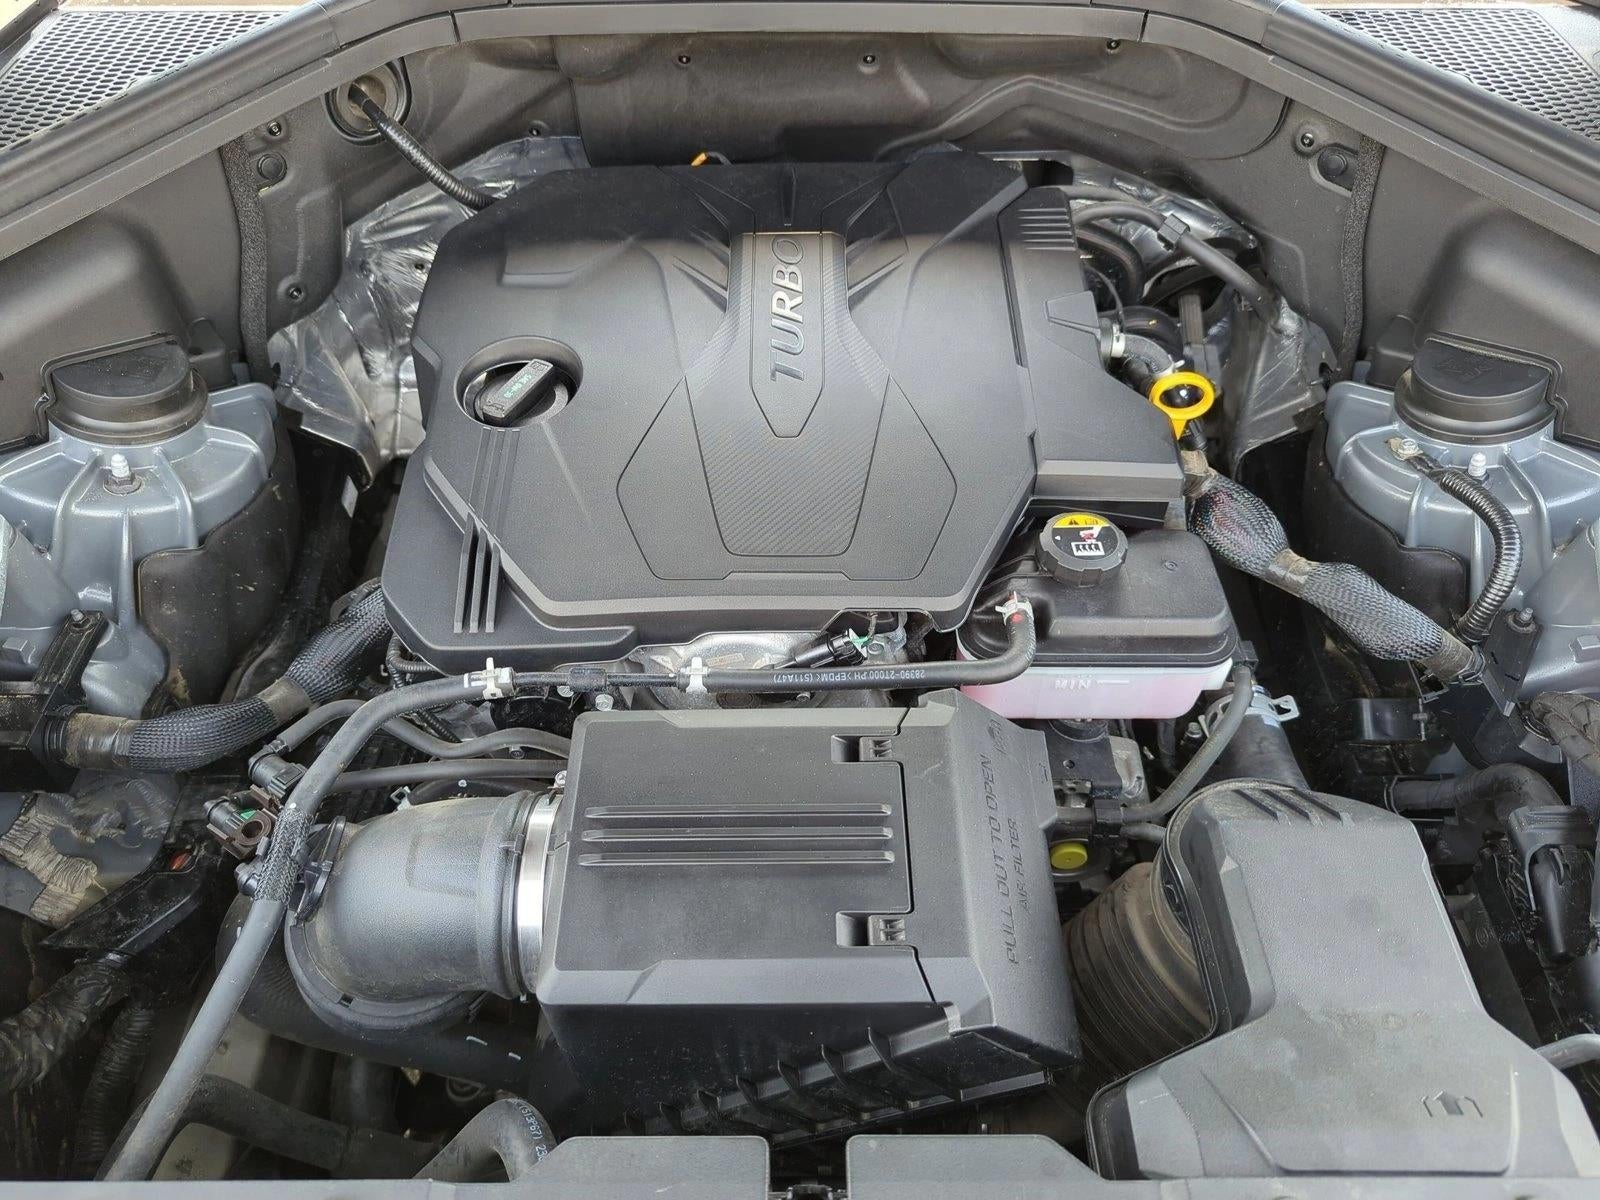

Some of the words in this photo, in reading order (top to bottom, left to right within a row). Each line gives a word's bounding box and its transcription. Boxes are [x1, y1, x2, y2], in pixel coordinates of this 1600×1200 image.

[770, 234, 805, 382] TURBO
[773, 672, 813, 684] (511A47)
[980, 753, 999, 812] OPEN
[988, 815, 1003, 844] TO
[1007, 818, 1025, 878] FILTER
[992, 847, 1010, 898] OUT
[1015, 879, 1032, 919] AIR
[1000, 905, 1019, 965] PULL
